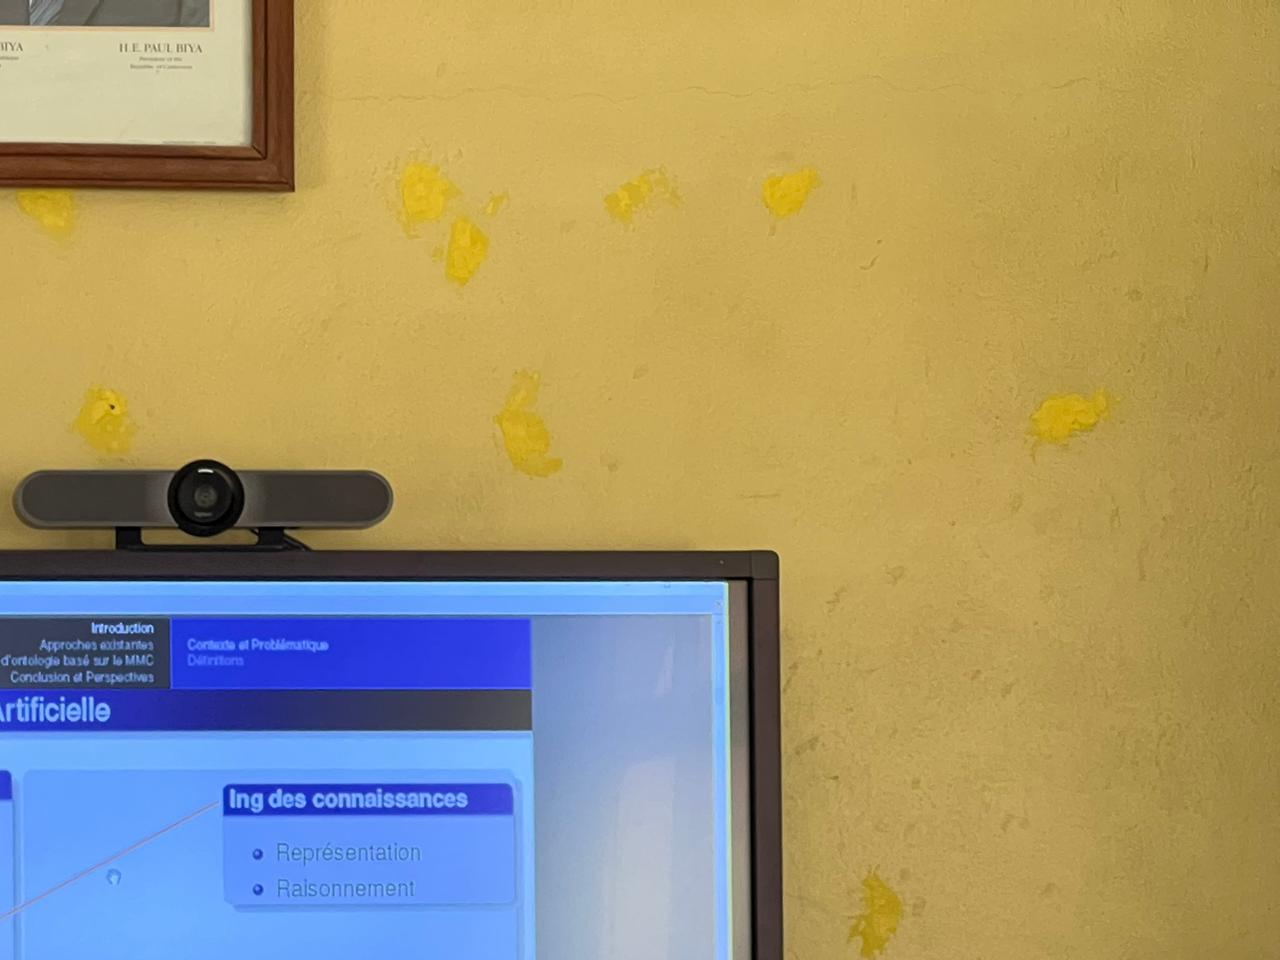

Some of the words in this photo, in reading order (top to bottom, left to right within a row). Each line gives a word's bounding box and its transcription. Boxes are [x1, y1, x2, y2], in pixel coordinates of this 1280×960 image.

[144, 43, 173, 53] PAUL
[176, 43, 202, 53] BIYA
[91, 622, 154, 634] Introduction
[40, 640, 98, 653] Approches
[100, 640, 154, 651] existantes
[187, 638, 236, 651] Contexte
[251, 638, 330, 653] Problématique
[1, 654, 60, 668] d'ontologie
[64, 654, 89, 666] basé
[94, 656, 109, 666] sur
[113, 655, 123, 666] le
[125, 654, 154, 666] MMC
[10, 671, 70, 683] Conclusion
[73, 672, 83, 683] et
[86, 671, 154, 685] Perspectives
[229, 788, 264, 813] Ing
[268, 788, 307, 809] des
[312, 788, 468, 809] connaissances
[276, 843, 421, 866] Représentation
[277, 878, 415, 898] Raisonnement
